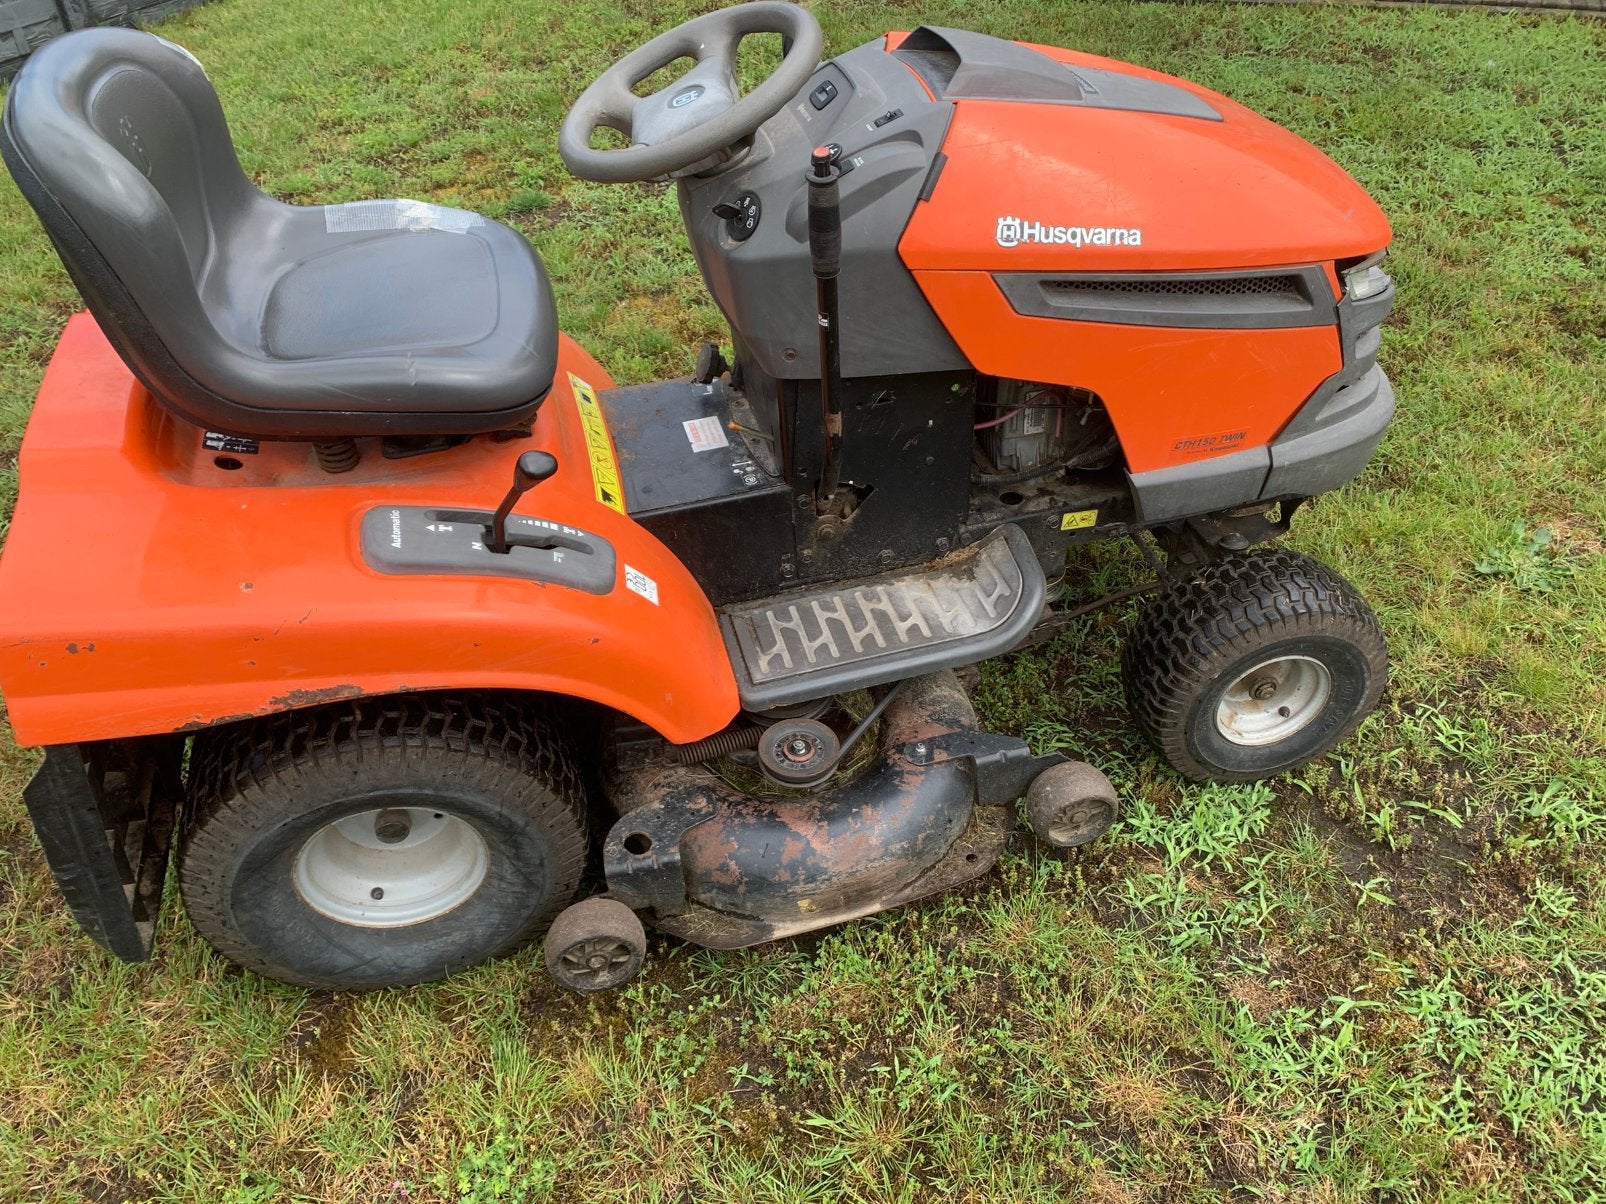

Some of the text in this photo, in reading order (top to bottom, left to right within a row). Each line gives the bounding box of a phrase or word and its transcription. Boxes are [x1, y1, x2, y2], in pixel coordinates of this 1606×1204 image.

[1023, 221, 1141, 247] Husqvarna
[1175, 432, 1247, 449] CTH150 TWIN
[390, 509, 401, 549] Automatic
